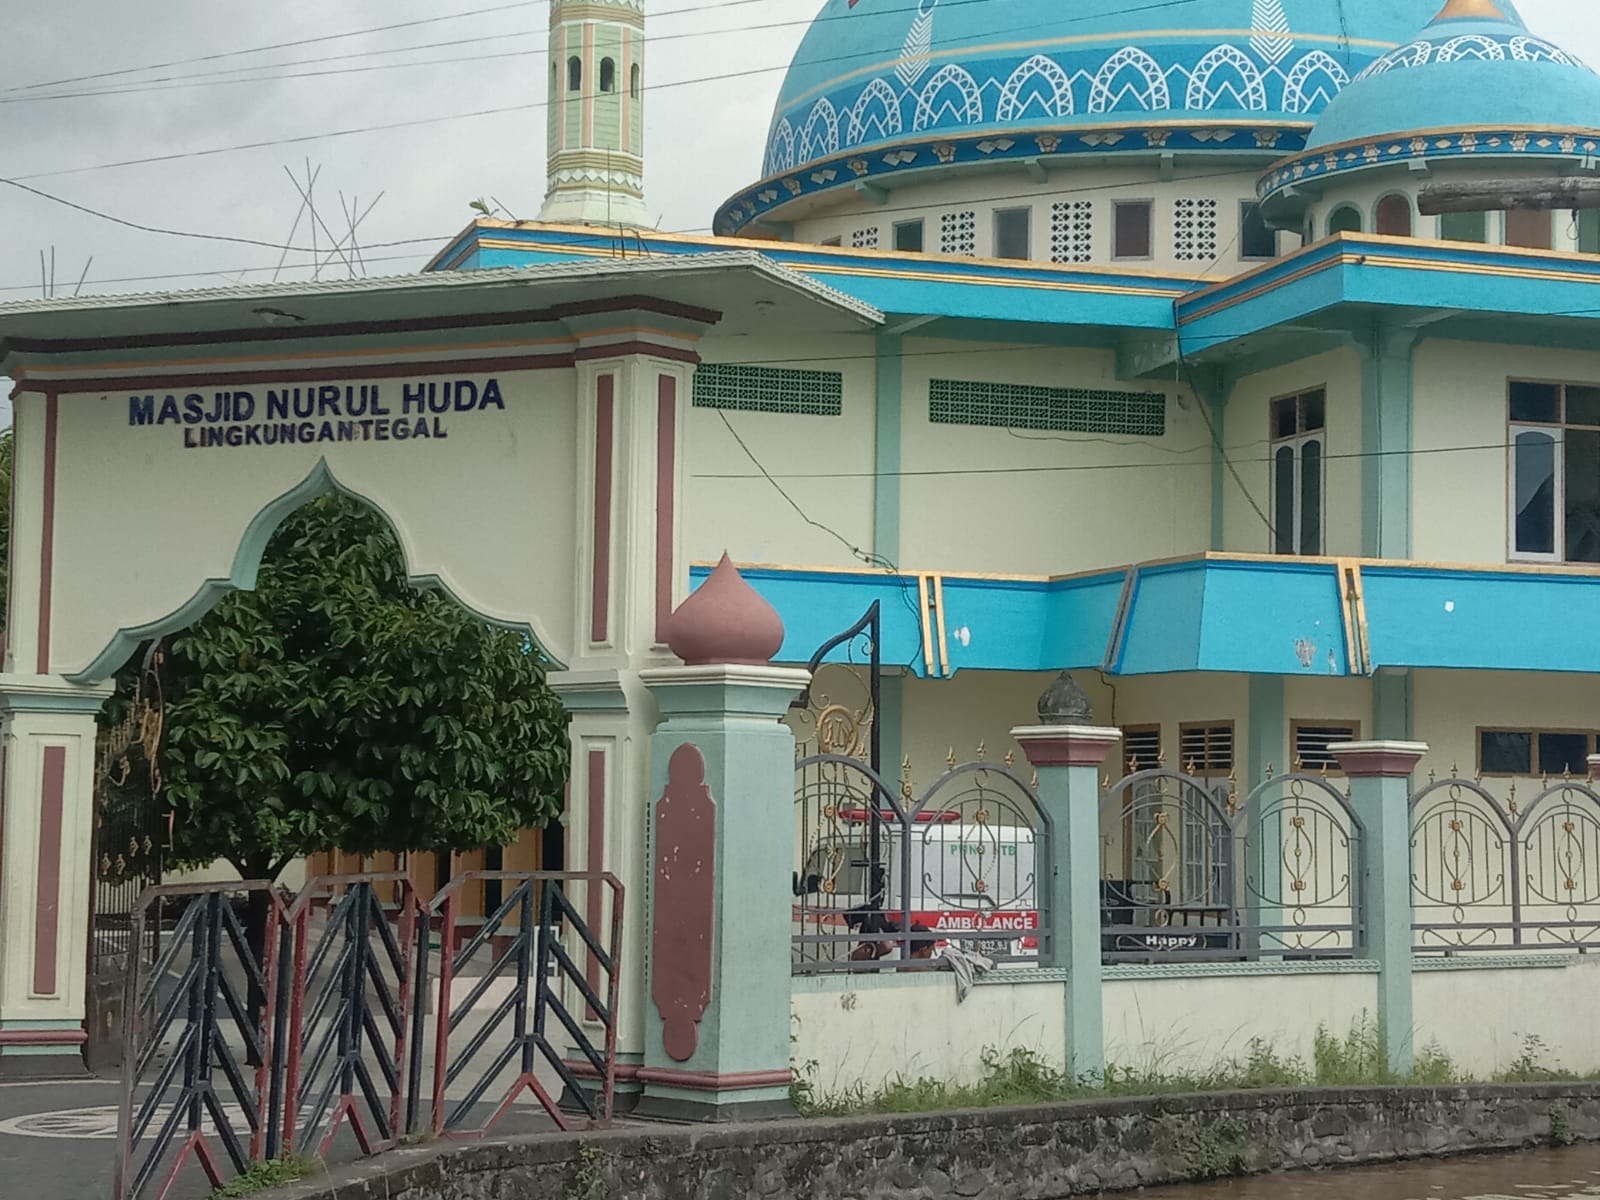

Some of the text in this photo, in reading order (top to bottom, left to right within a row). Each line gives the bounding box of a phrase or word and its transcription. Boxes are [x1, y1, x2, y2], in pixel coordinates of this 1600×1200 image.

[128, 378, 506, 426] MASJID NURUL HUDA
[936, 916, 1034, 930] AMBULANCE
[1145, 935, 1198, 947] Happy
